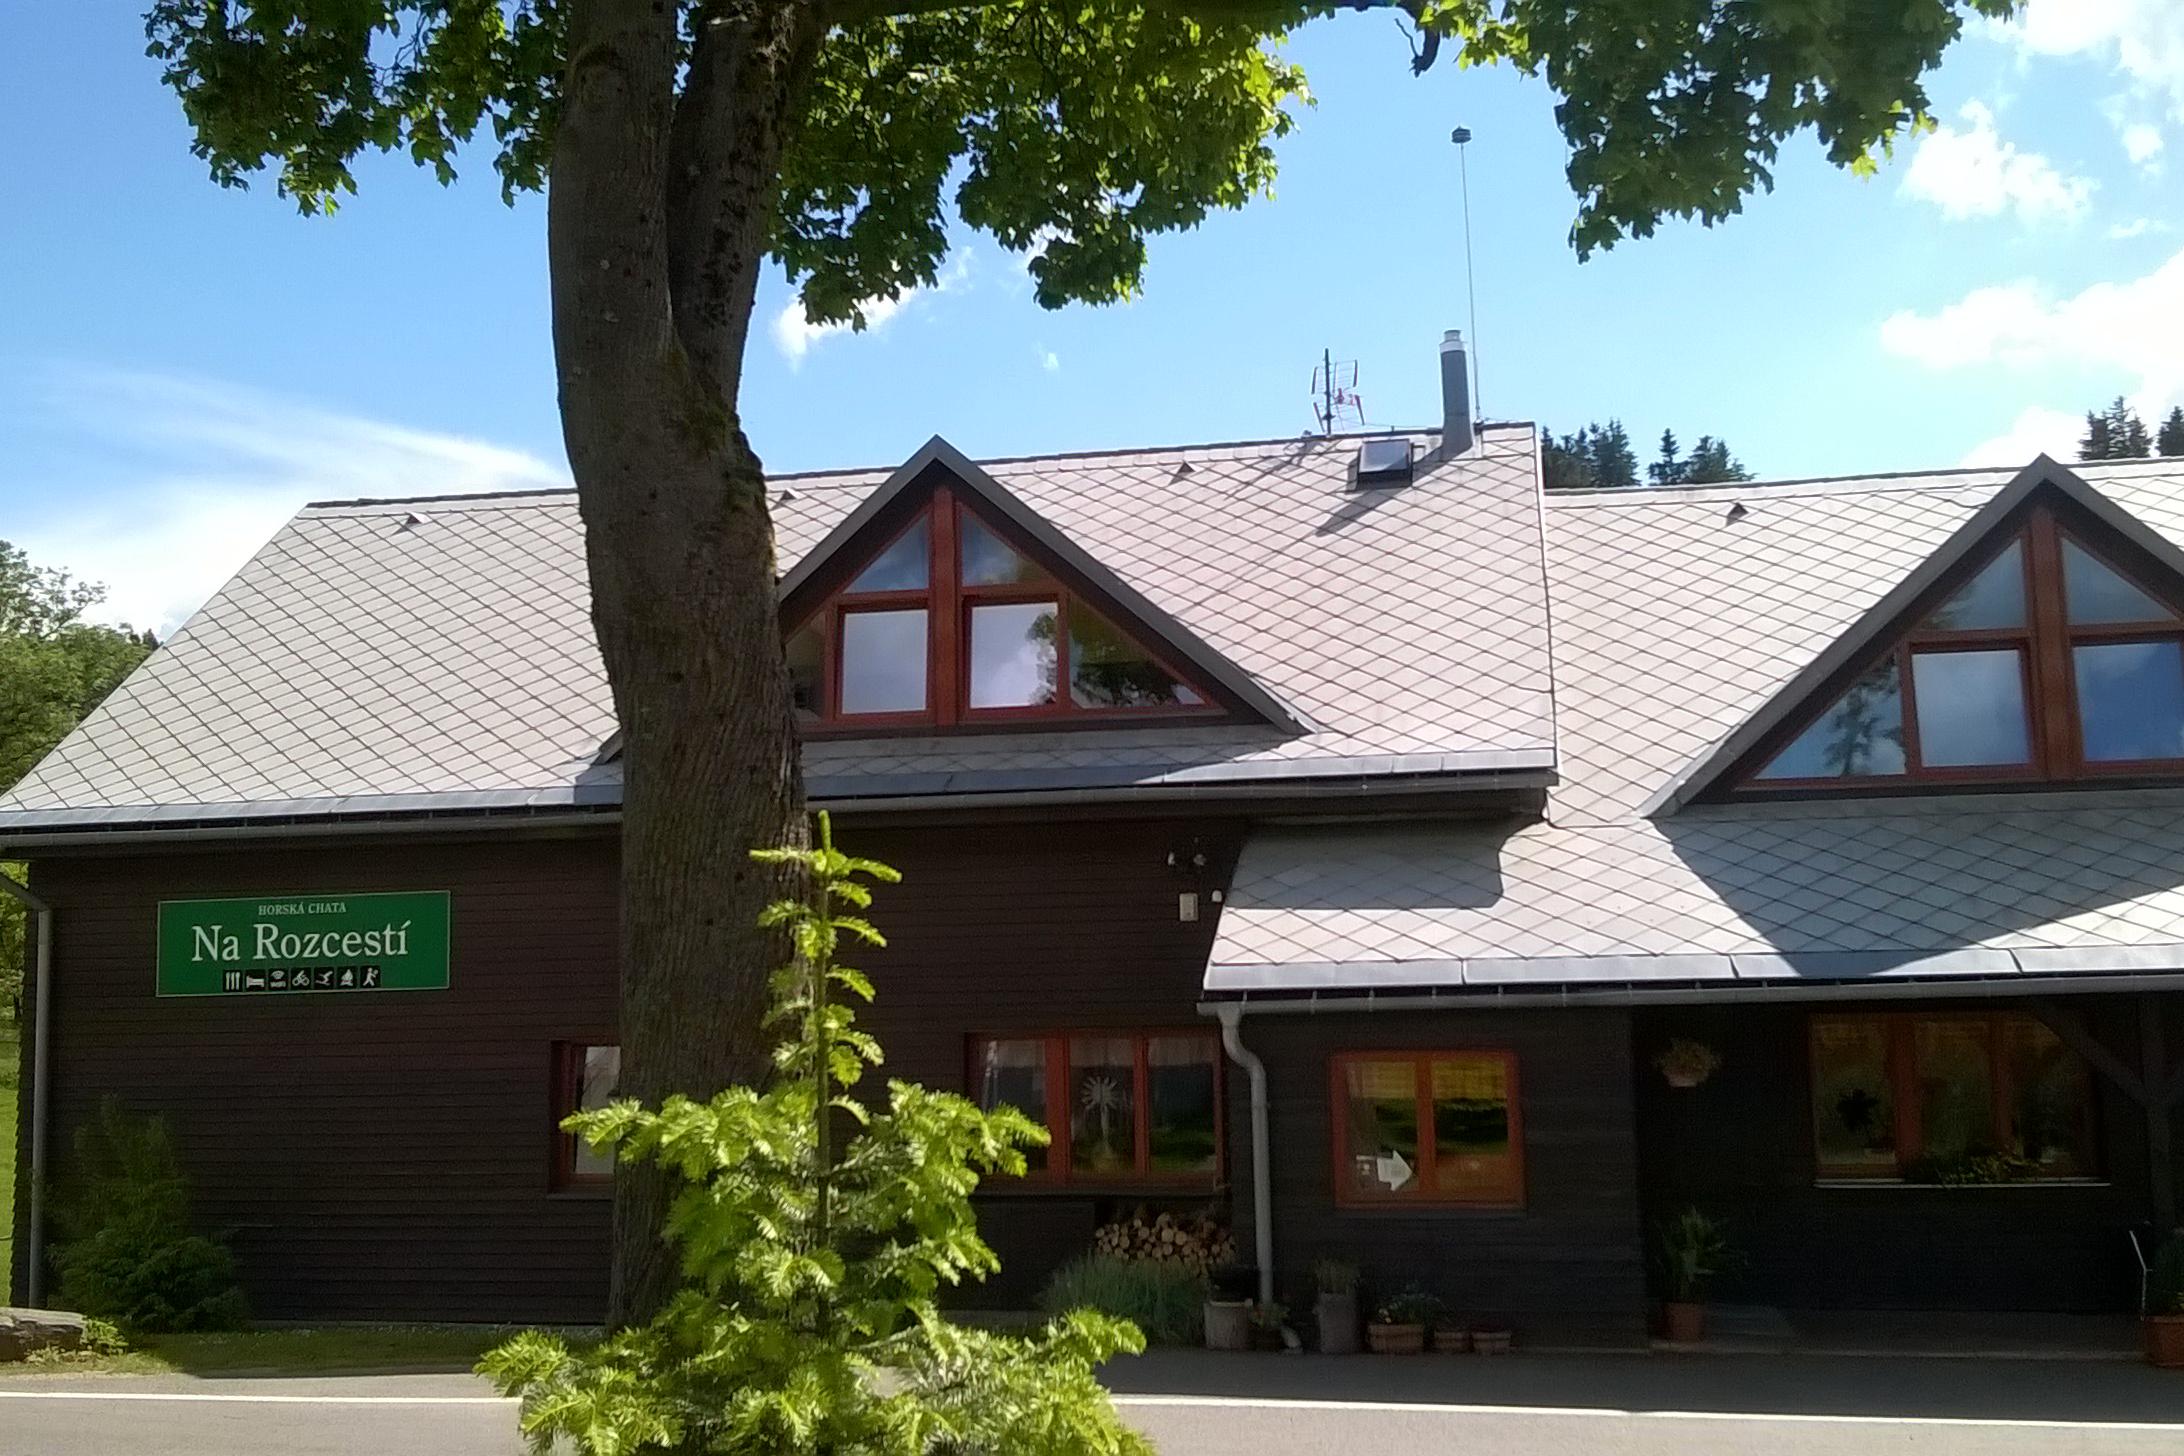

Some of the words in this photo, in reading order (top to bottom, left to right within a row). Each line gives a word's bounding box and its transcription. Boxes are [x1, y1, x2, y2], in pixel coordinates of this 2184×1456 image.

[258, 902, 304, 916] HORSKÁ
[308, 902, 347, 914] CHATA
[192, 925, 240, 961] Na
[253, 920, 411, 960] Rozcestí
